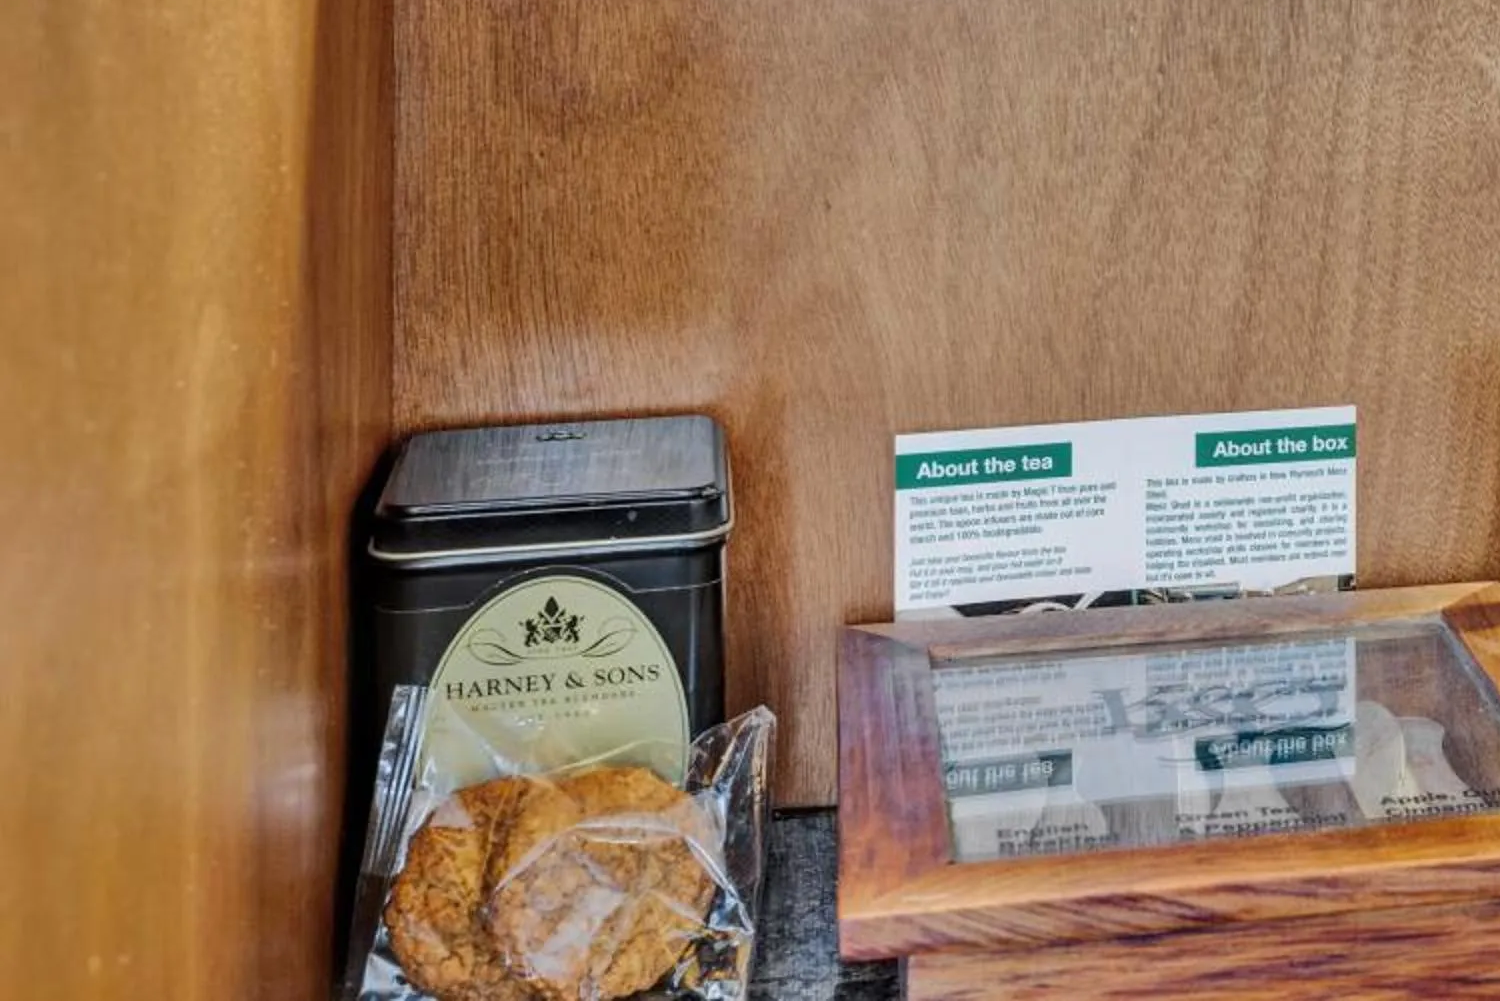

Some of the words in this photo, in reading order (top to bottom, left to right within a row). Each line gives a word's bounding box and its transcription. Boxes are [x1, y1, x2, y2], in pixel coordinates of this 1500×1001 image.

[1213, 439, 1272, 458] About
[1277, 436, 1307, 453] the
[1312, 435, 1348, 452] box
[916, 459, 978, 479] About
[984, 456, 1016, 474] the
[1021, 455, 1053, 471] tea
[446, 673, 555, 699] HARNEY
[565, 672, 584, 689] &
[594, 664, 660, 686] SONS
[1381, 792, 1456, 805] Apple,
[1175, 810, 1248, 823] Green
[1257, 806, 1300, 817] Tea
[997, 824, 1089, 842] English
